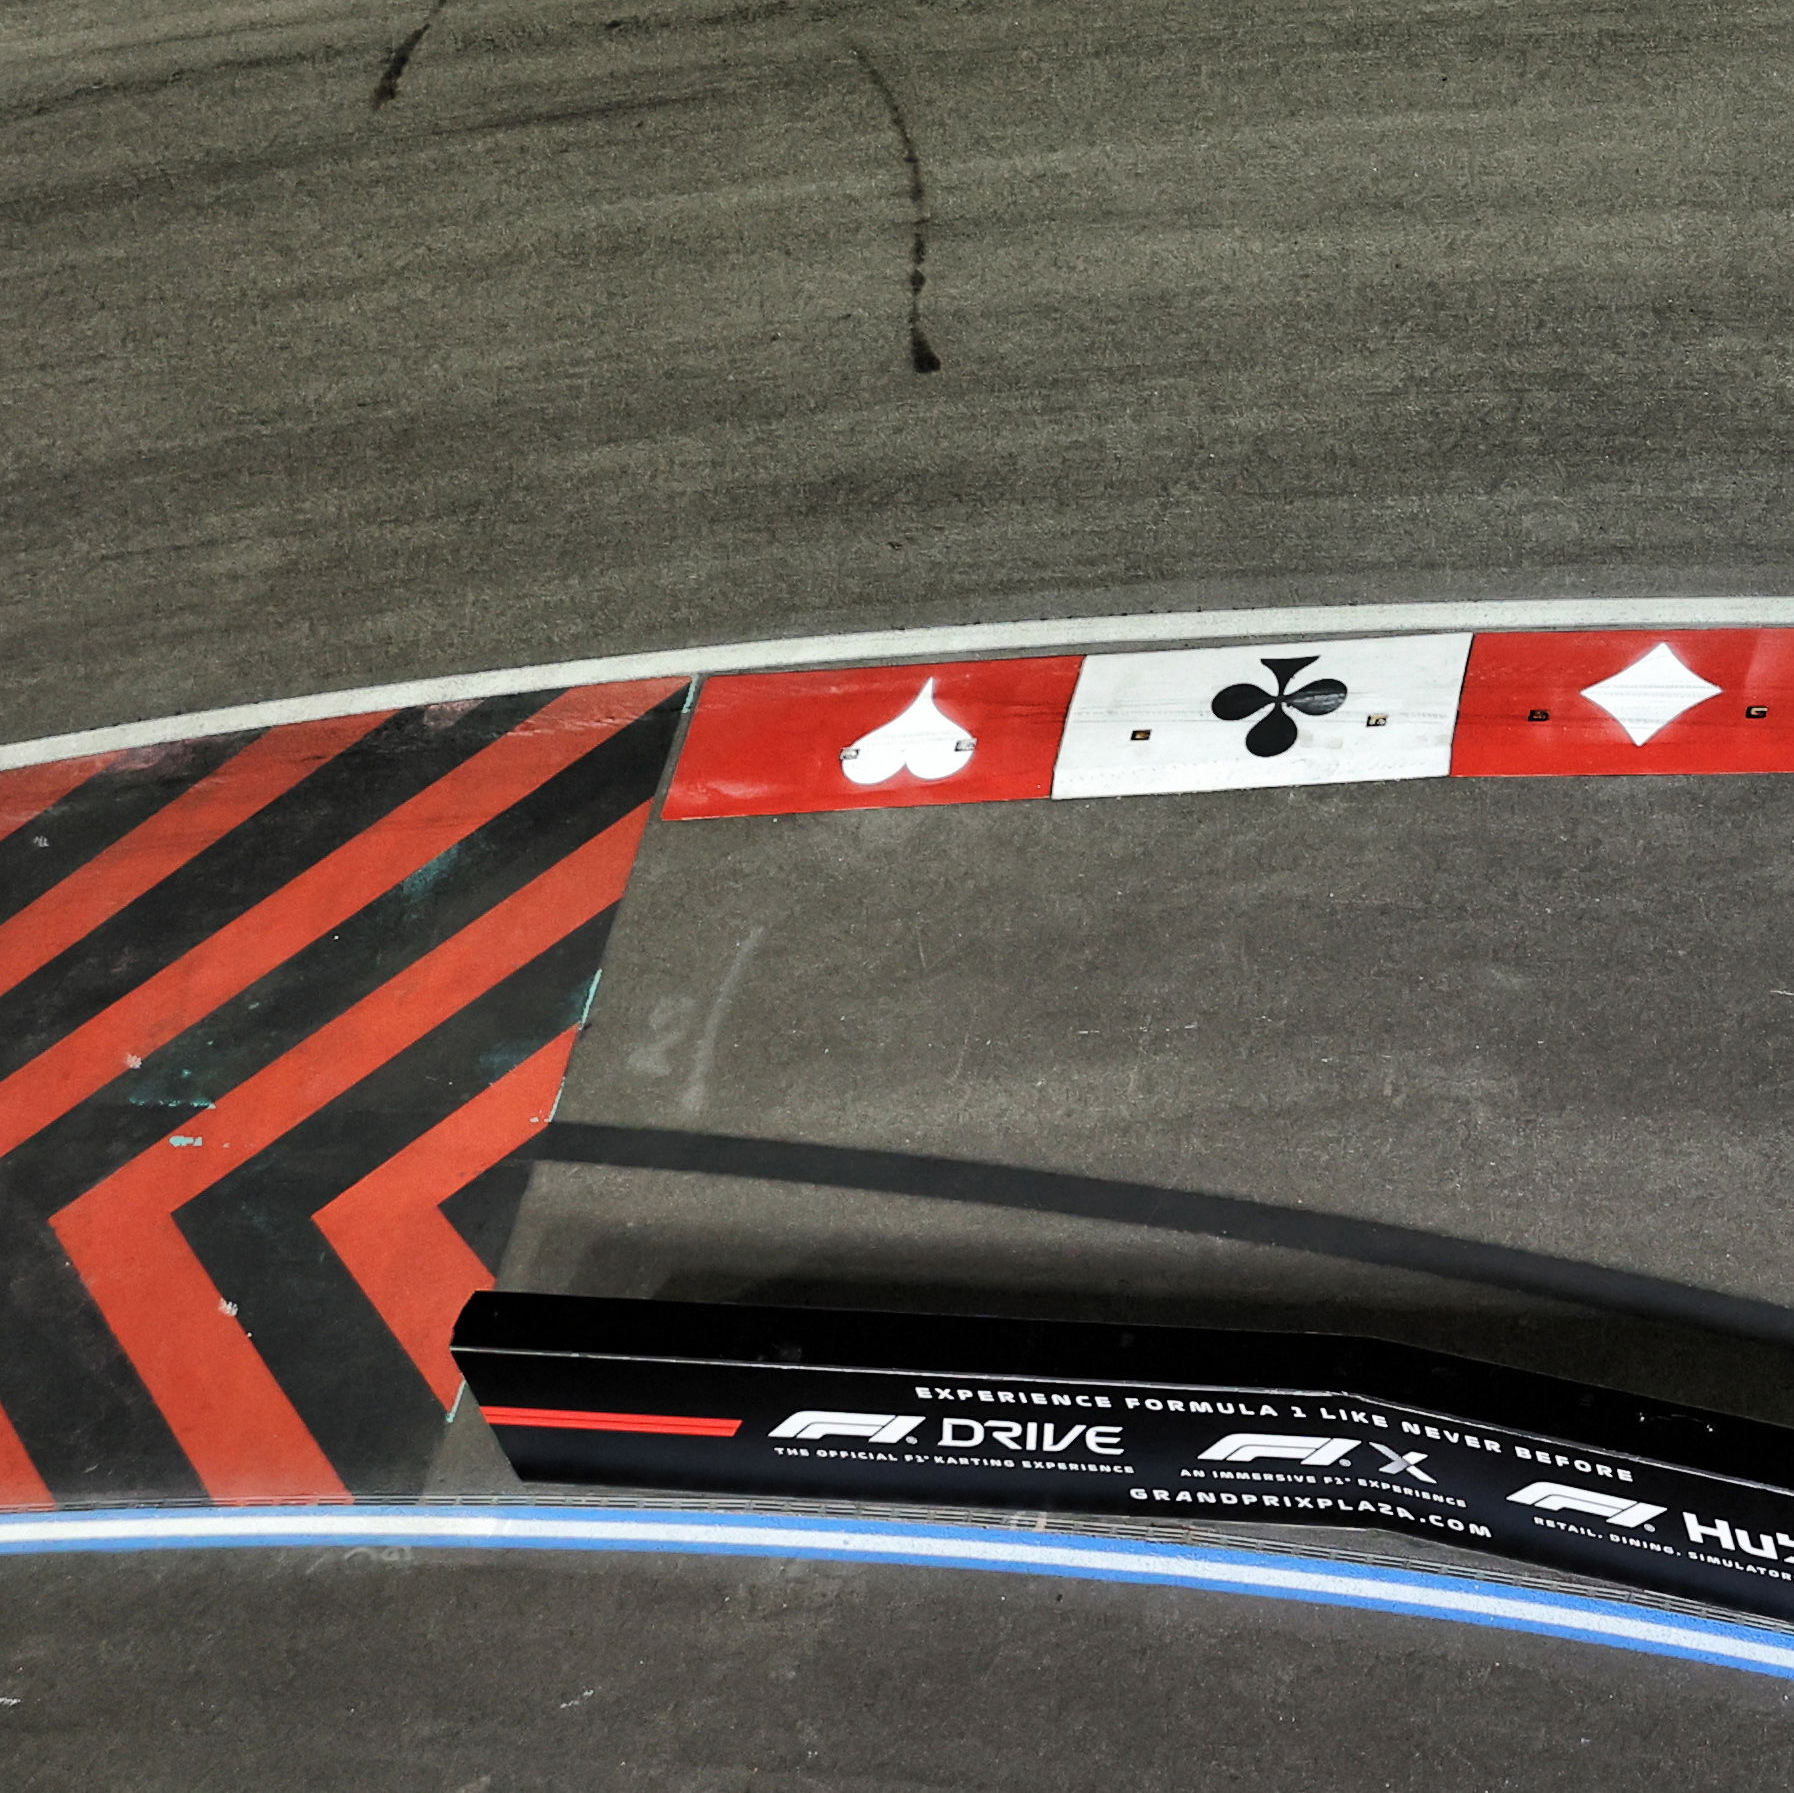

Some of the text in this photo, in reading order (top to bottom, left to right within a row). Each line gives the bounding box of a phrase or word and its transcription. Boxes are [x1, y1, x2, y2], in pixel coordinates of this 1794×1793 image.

[768, 1410, 1126, 1456] F1 DRIVE
[915, 1387, 1634, 1483] EXPERIENCE FORMULA 1 LIKE NEVER BEFORE
[774, 1447, 812, 1458] THE
[816, 1449, 898, 1462] OFFICIAL
[935, 1455, 1015, 1470] KARTING
[1022, 1460, 1136, 1475] EXPERIENCE
[1197, 1432, 1437, 1484] F1 X
[1180, 1468, 1207, 1478] AN
[1212, 1471, 1317, 1485] IMMERSIVE
[1357, 1479, 1468, 1509] EXPERIENCE
[1506, 1481, 1668, 1528] F1
[1129, 1488, 1493, 1539] GRANDPRIXPLAZA.COM
[1534, 1516, 1604, 1539] RETAIL.
[1609, 1533, 1682, 1558] DINING.
